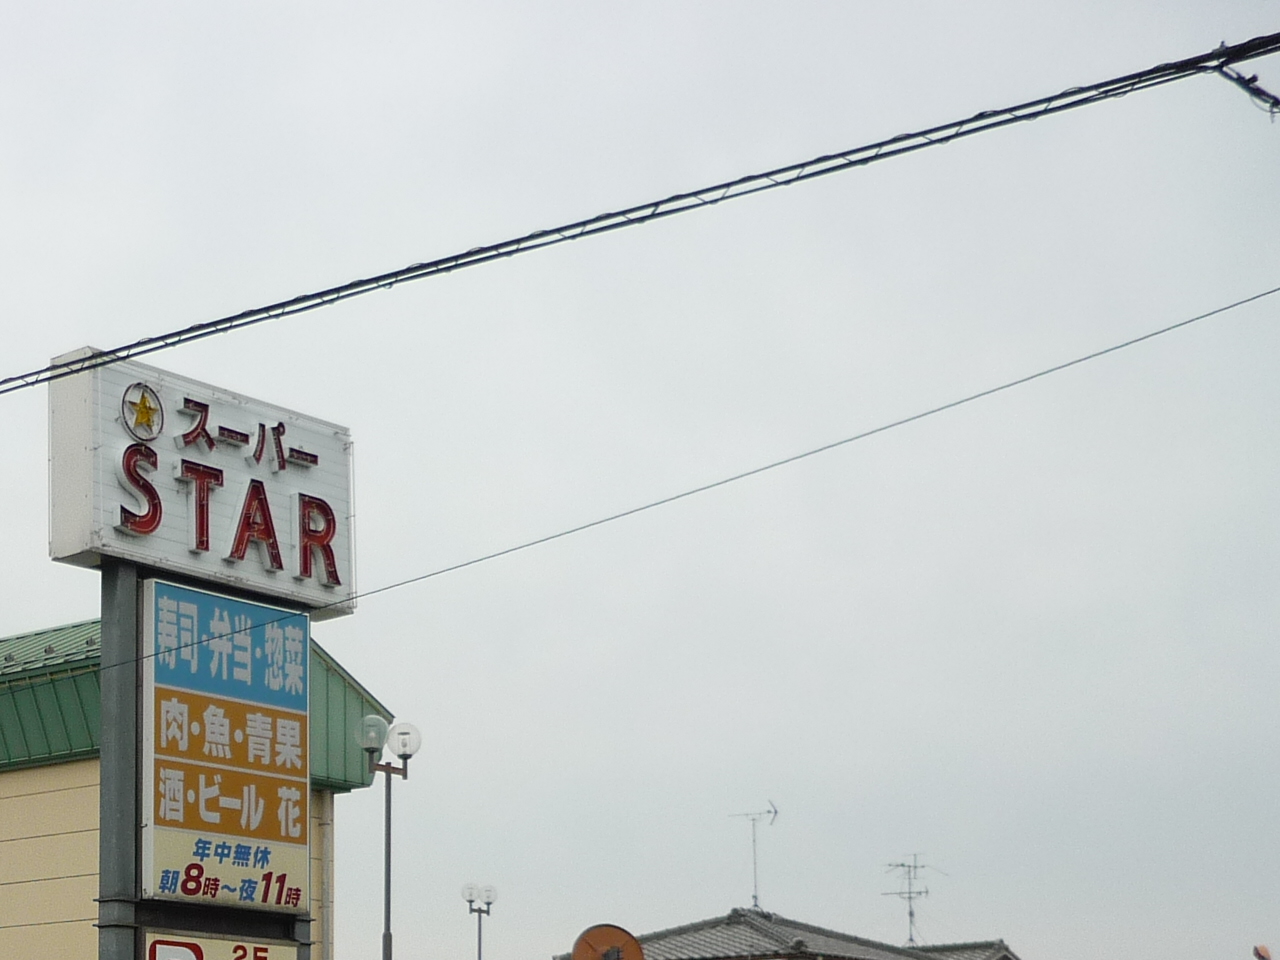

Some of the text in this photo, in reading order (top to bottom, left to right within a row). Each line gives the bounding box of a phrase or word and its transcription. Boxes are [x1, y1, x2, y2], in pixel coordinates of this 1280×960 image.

[174, 396, 319, 472] スーパー
[118, 442, 342, 588] STAR
[160, 697, 303, 770] 肉・魚・青果
[276, 785, 302, 839] 花
[192, 837, 272, 870] 年中無休
